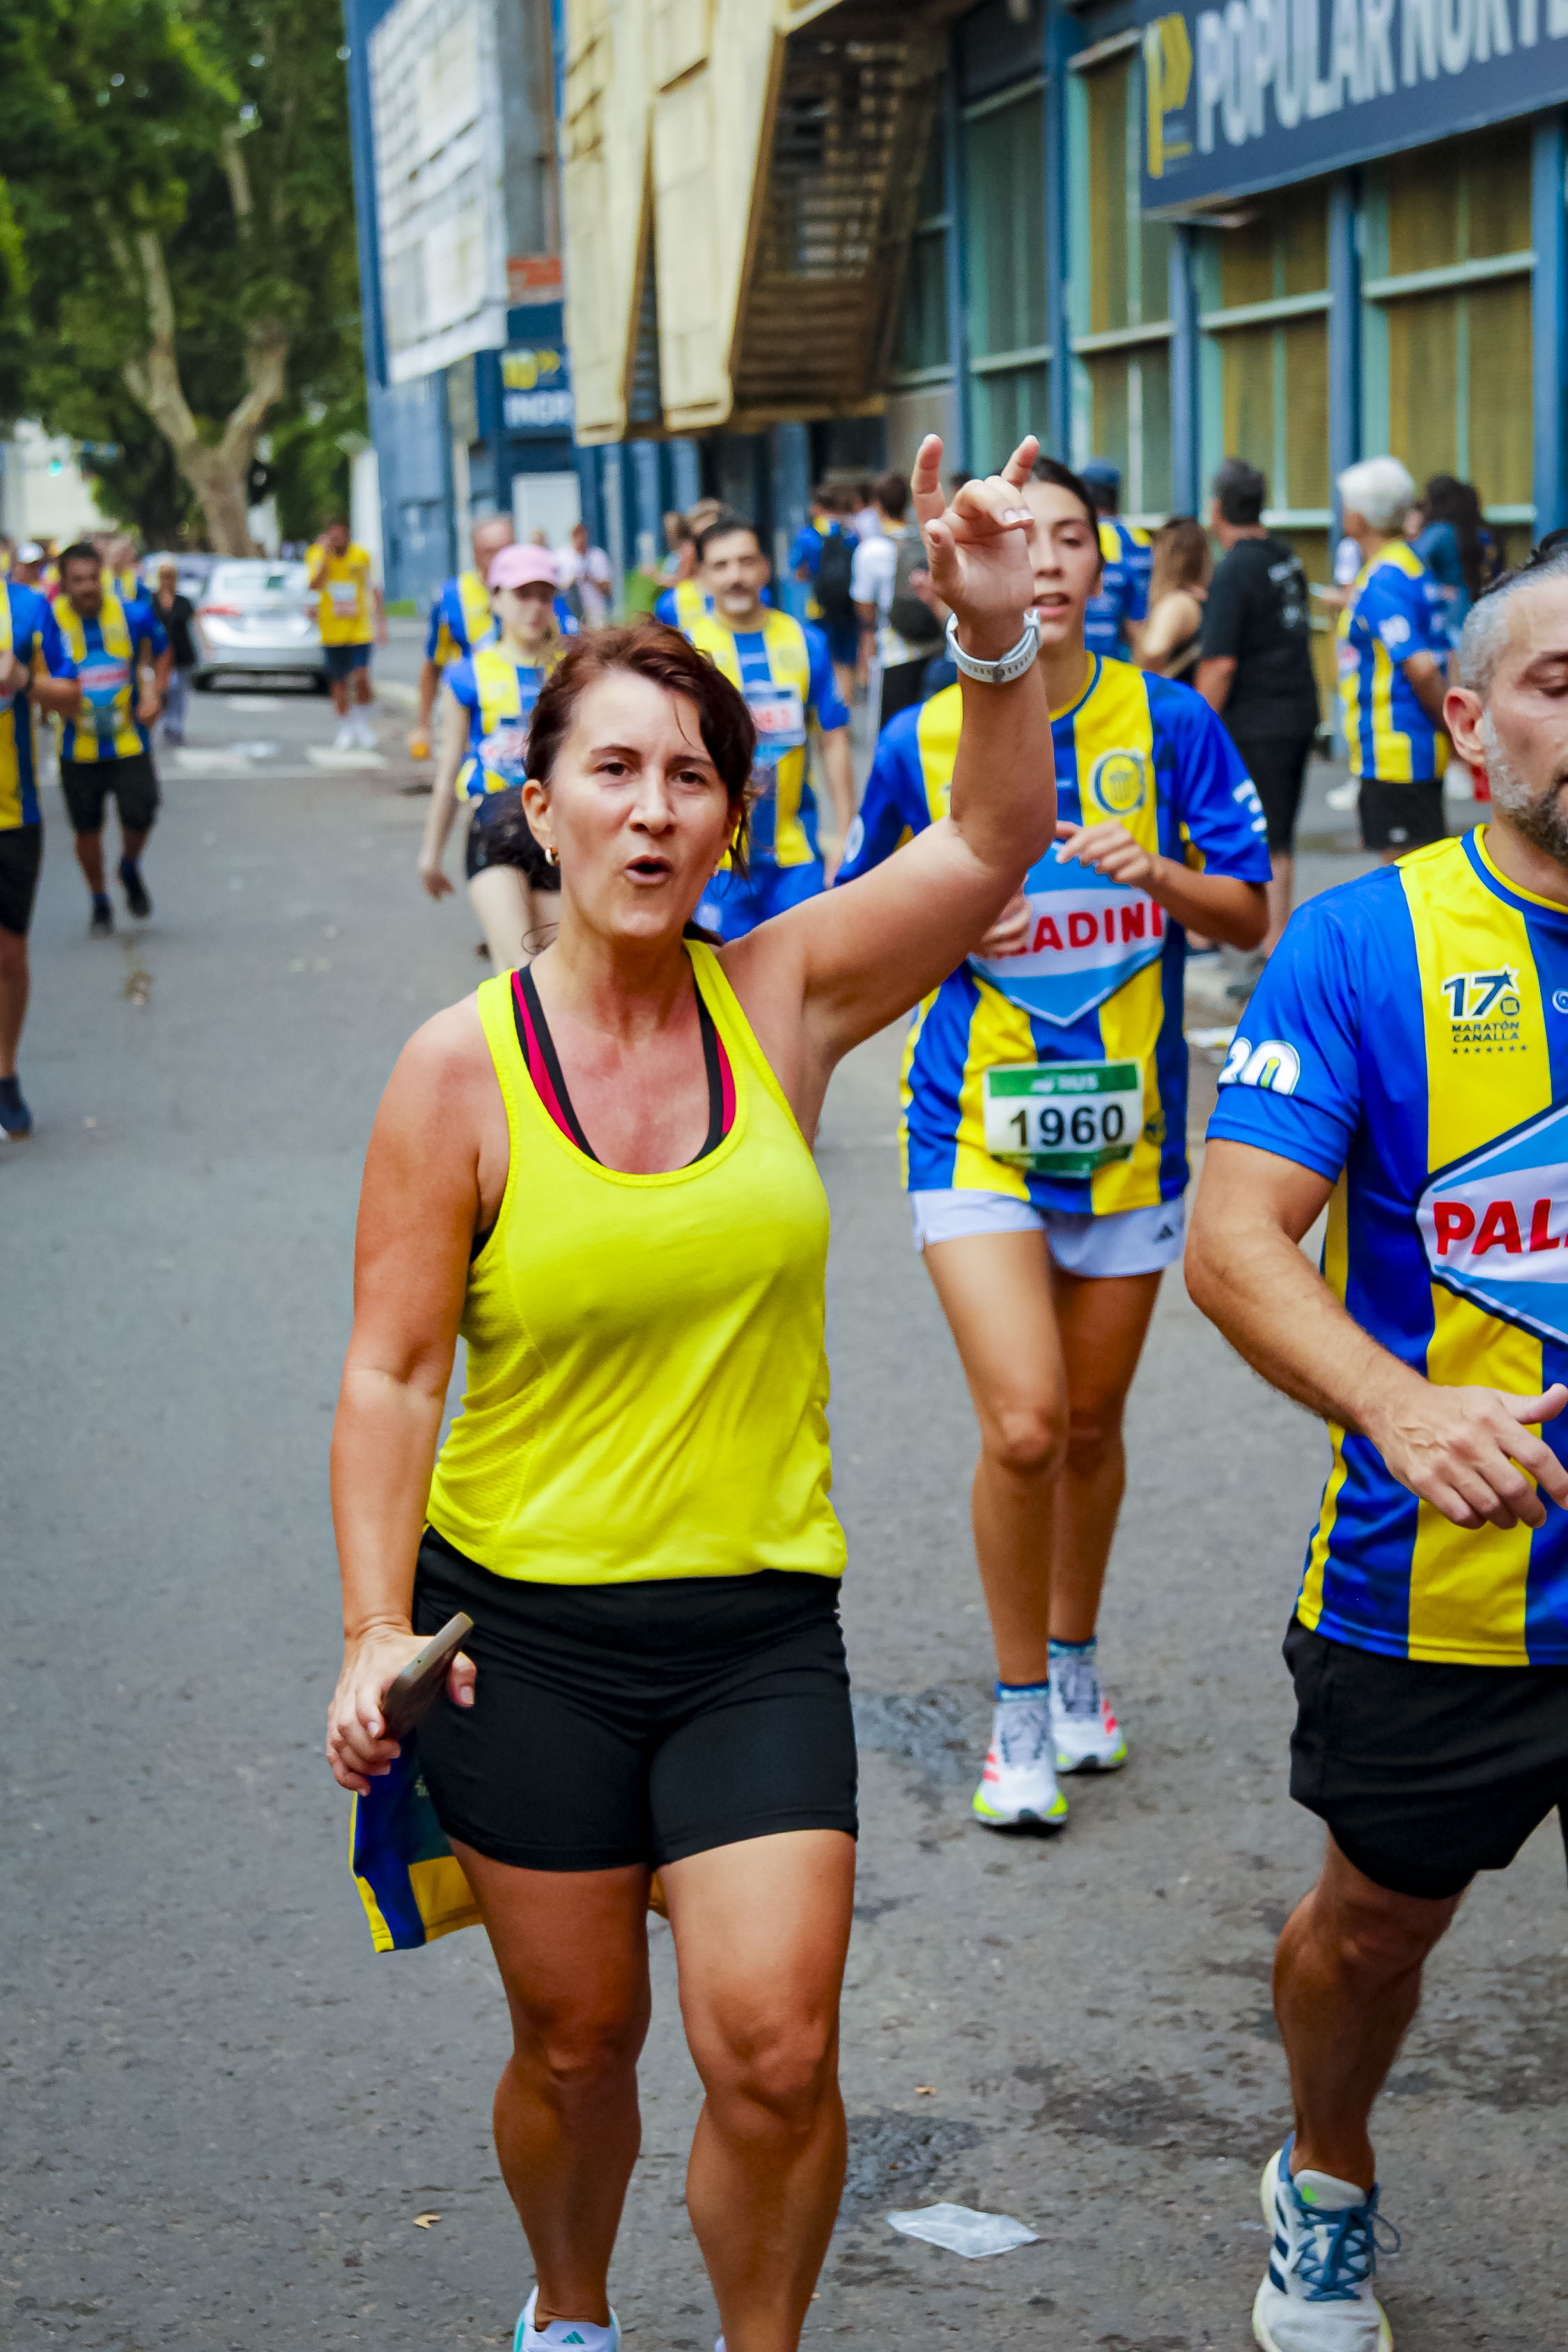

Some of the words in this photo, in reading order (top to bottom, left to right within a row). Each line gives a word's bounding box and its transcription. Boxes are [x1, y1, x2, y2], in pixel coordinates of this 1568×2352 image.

[1195, 0, 1397, 155] POPULAR
[998, 901, 1162, 958] ADINI
[1441, 967, 1520, 1021] 17
[1452, 1019, 1519, 1032] MARATÓN
[1453, 1032, 1519, 1042] CANALLA
[1010, 1104, 1124, 1147] 1960
[1434, 1198, 1568, 1255] PAL
